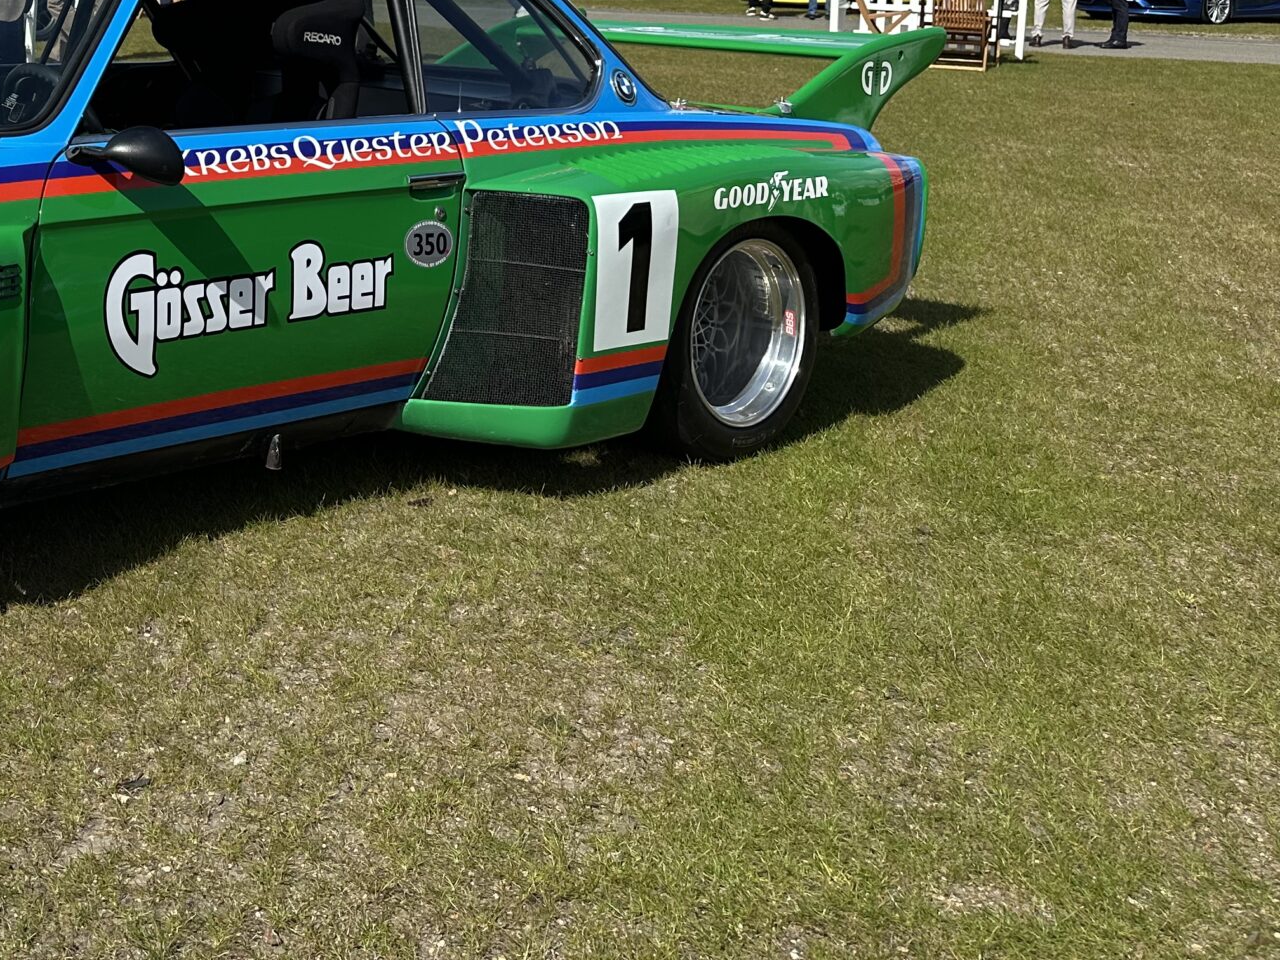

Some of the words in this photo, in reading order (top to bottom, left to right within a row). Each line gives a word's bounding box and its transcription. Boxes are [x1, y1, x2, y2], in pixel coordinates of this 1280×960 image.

[303, 31, 342, 46] RECARO
[412, 232, 448, 256] 350
[617, 200, 654, 334] 1
[104, 252, 276, 378] Gösser
[286, 240, 394, 322] Beer
[785, 310, 795, 336] BBS
